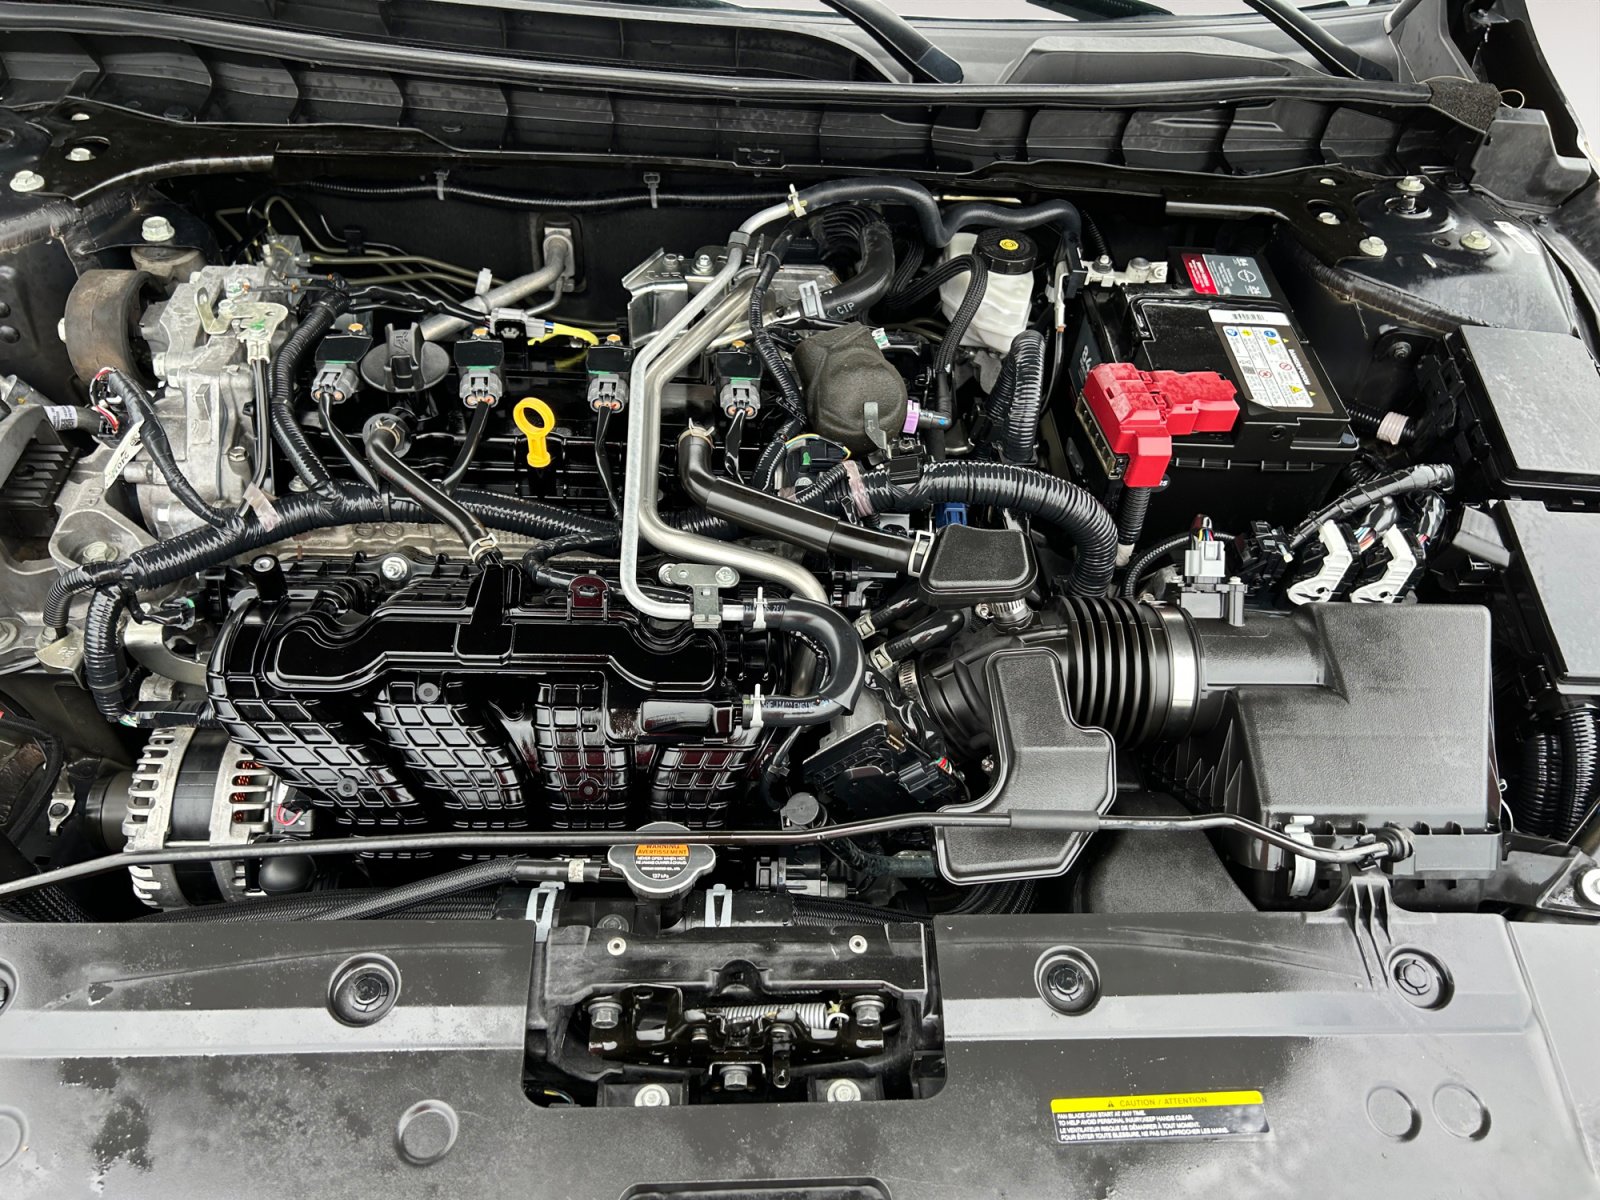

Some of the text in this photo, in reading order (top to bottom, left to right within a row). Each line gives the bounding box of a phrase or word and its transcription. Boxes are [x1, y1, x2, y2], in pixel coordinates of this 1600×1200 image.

[836, 302, 854, 314] CIP
[1120, 1099, 1155, 1107] CAUTION
[1164, 1097, 1207, 1105] ATTENTION
